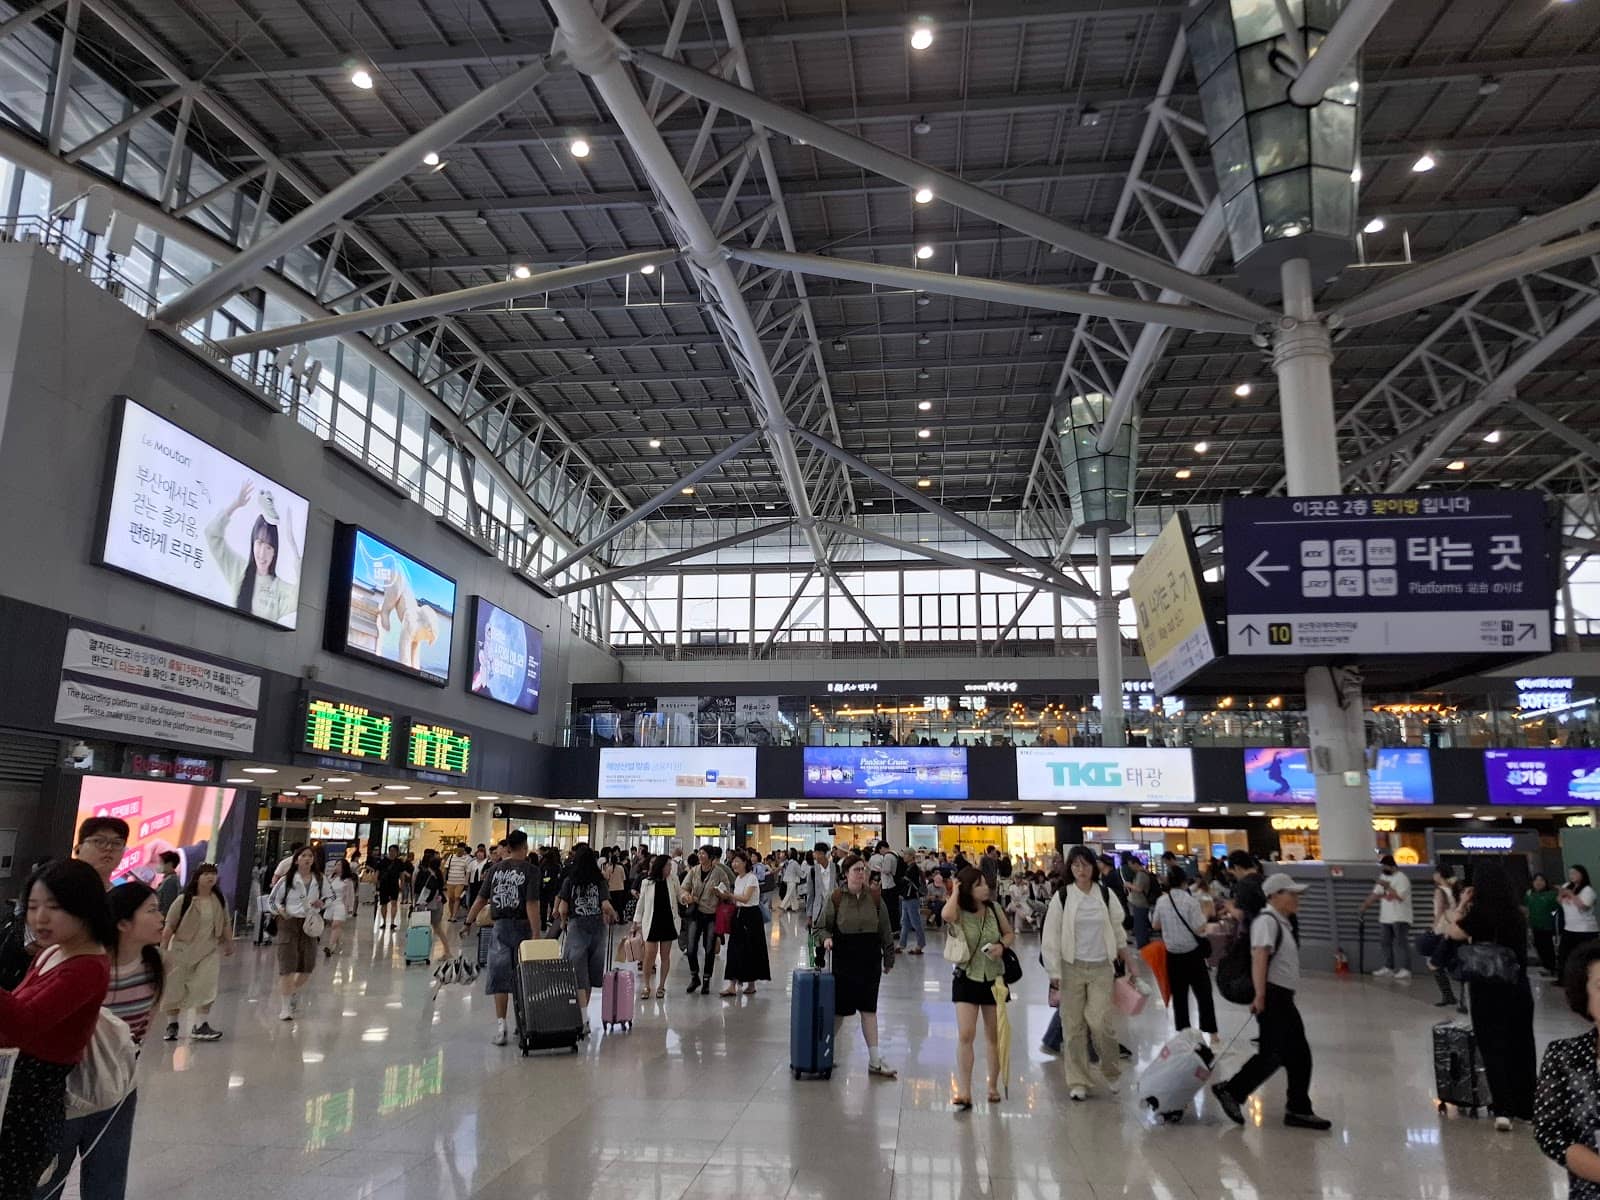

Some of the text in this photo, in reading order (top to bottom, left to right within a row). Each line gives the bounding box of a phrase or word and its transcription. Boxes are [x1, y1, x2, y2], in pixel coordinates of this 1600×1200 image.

[154, 441, 192, 468] Mouton
[136, 464, 199, 510] 부산에서도
[134, 492, 159, 520] 걷는
[1293, 501, 1340, 516] 이곳은
[1344, 500, 1368, 516] 2층
[1422, 497, 1470, 513] 입니다
[129, 521, 168, 554] 편하게
[1407, 535, 1522, 571] 타는 곳
[1409, 582, 1463, 593] Platforms
[1270, 625, 1290, 642] 10
[92, 655, 117, 671] 반드시
[67, 687, 81, 697] The
[81, 690, 111, 706] boarding
[111, 698, 138, 709] platform
[150, 704, 158, 713] be
[923, 696, 986, 711] 김밥 국밥
[145, 716, 161, 726] check
[162, 719, 172, 728] the
[172, 720, 195, 732] platform
[1046, 762, 1163, 788] TKG 태광
[788, 813, 882, 823] DOUGHNUTS & COFFEE
[977, 815, 1014, 824] FRIENDS
